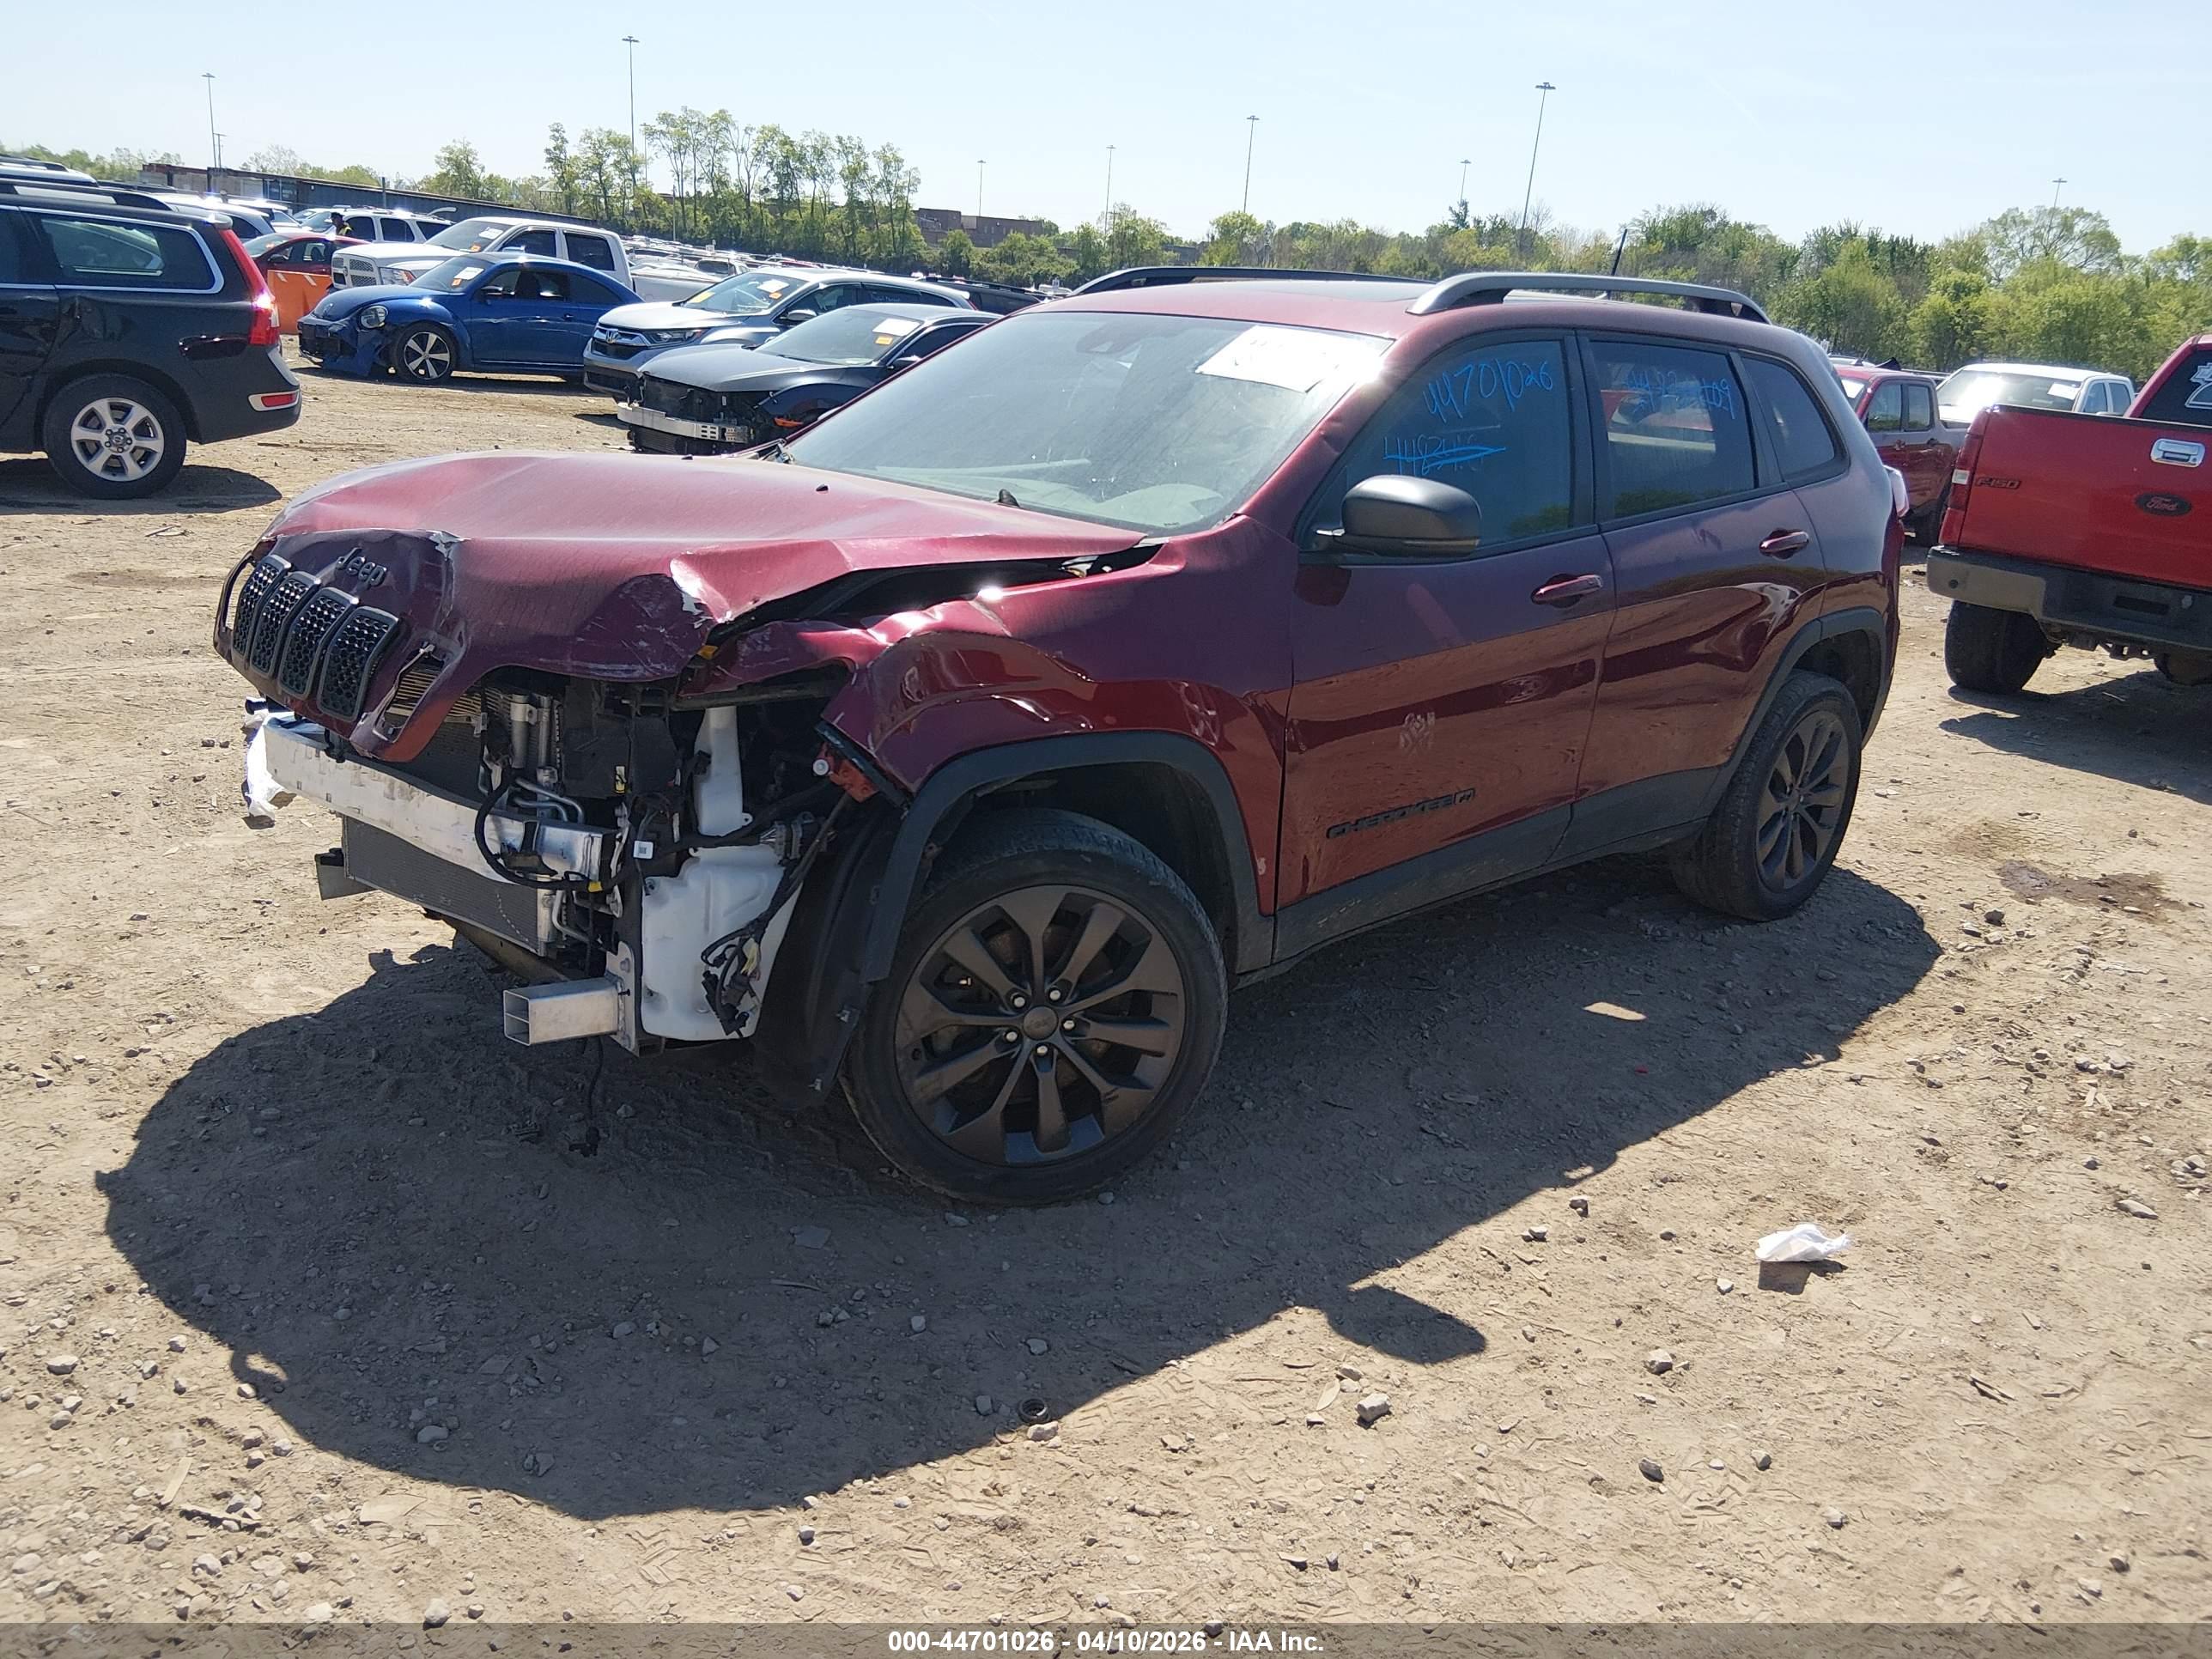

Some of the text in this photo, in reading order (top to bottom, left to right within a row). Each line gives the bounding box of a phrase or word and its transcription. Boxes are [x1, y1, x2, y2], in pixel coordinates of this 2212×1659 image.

[1422, 358, 1553, 423] 44701026
[1975, 476, 2022, 490] F-150
[335, 547, 387, 591] Jeep
[1325, 793, 1454, 839] CHEROKEE
